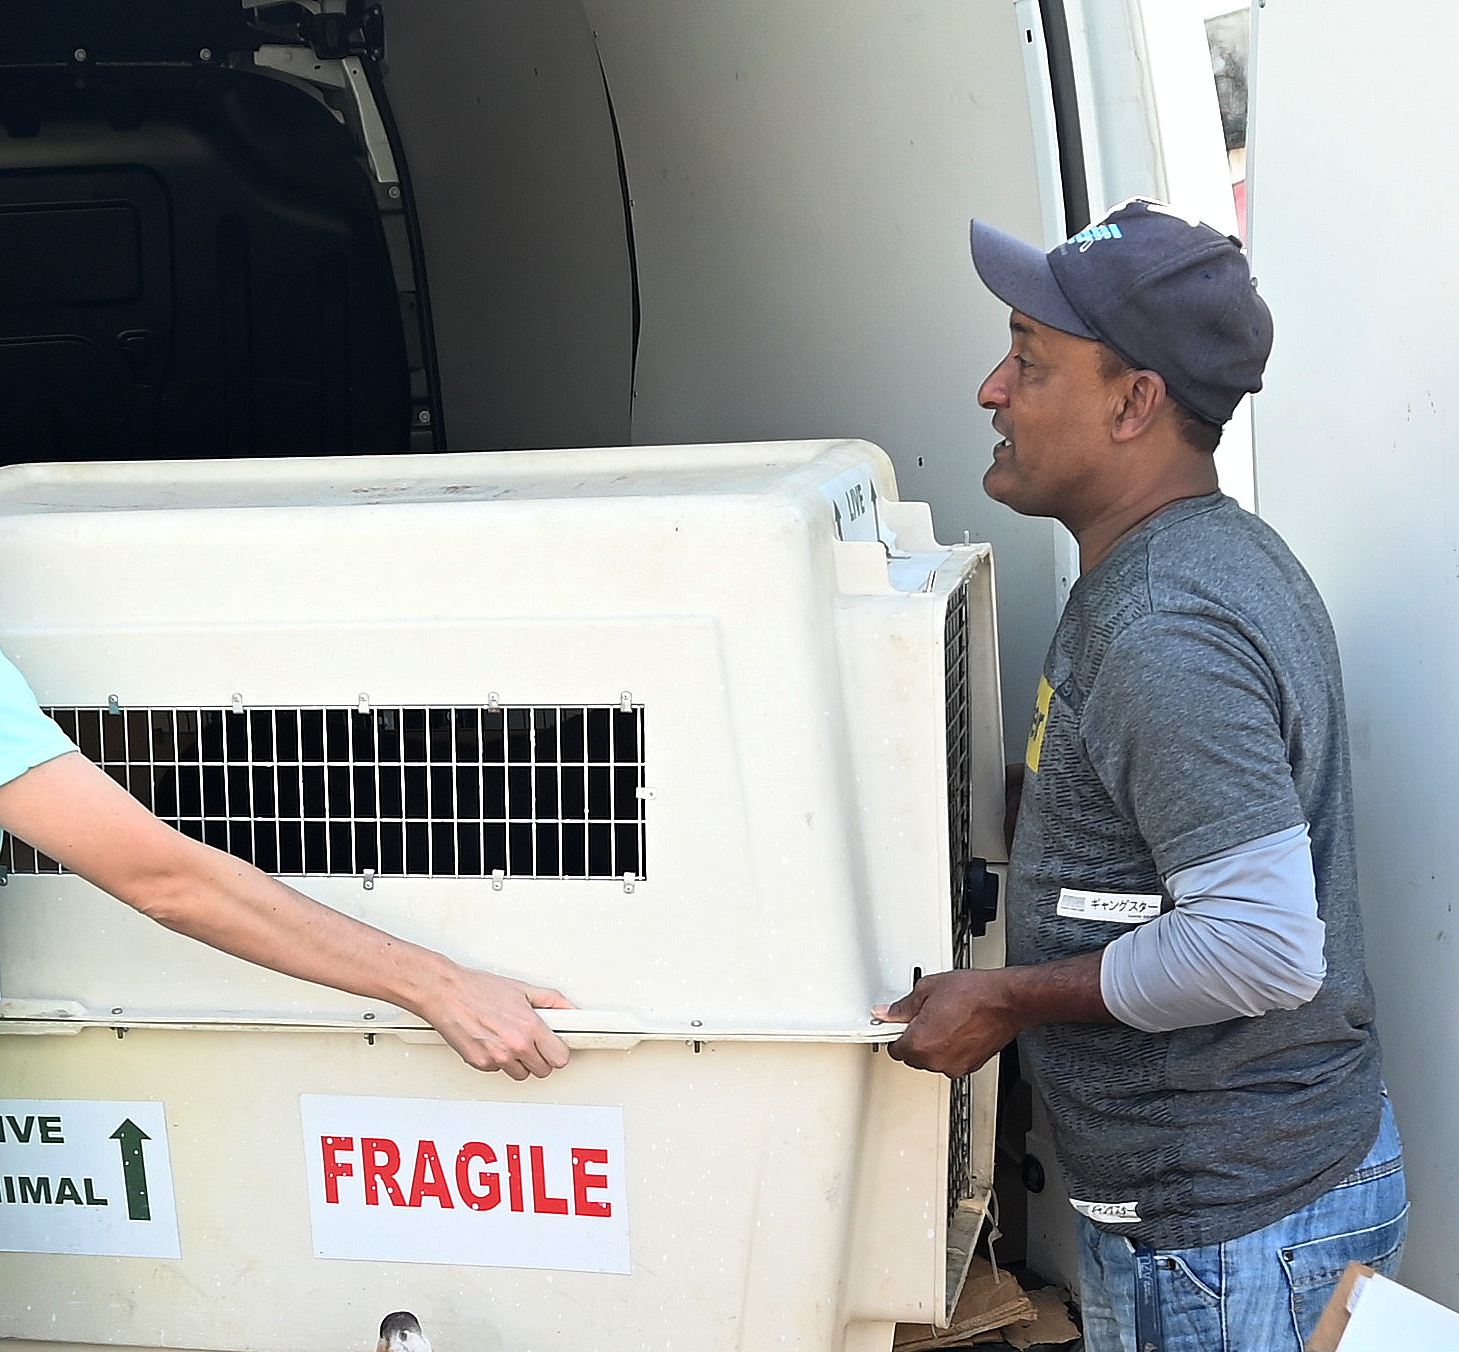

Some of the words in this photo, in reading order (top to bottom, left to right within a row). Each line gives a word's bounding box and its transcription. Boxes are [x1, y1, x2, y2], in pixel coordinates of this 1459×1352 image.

[845, 484, 866, 522] LIVE
[1090, 898, 1159, 913] ギャングスター
[321, 1135, 612, 1218] FRAGILE
